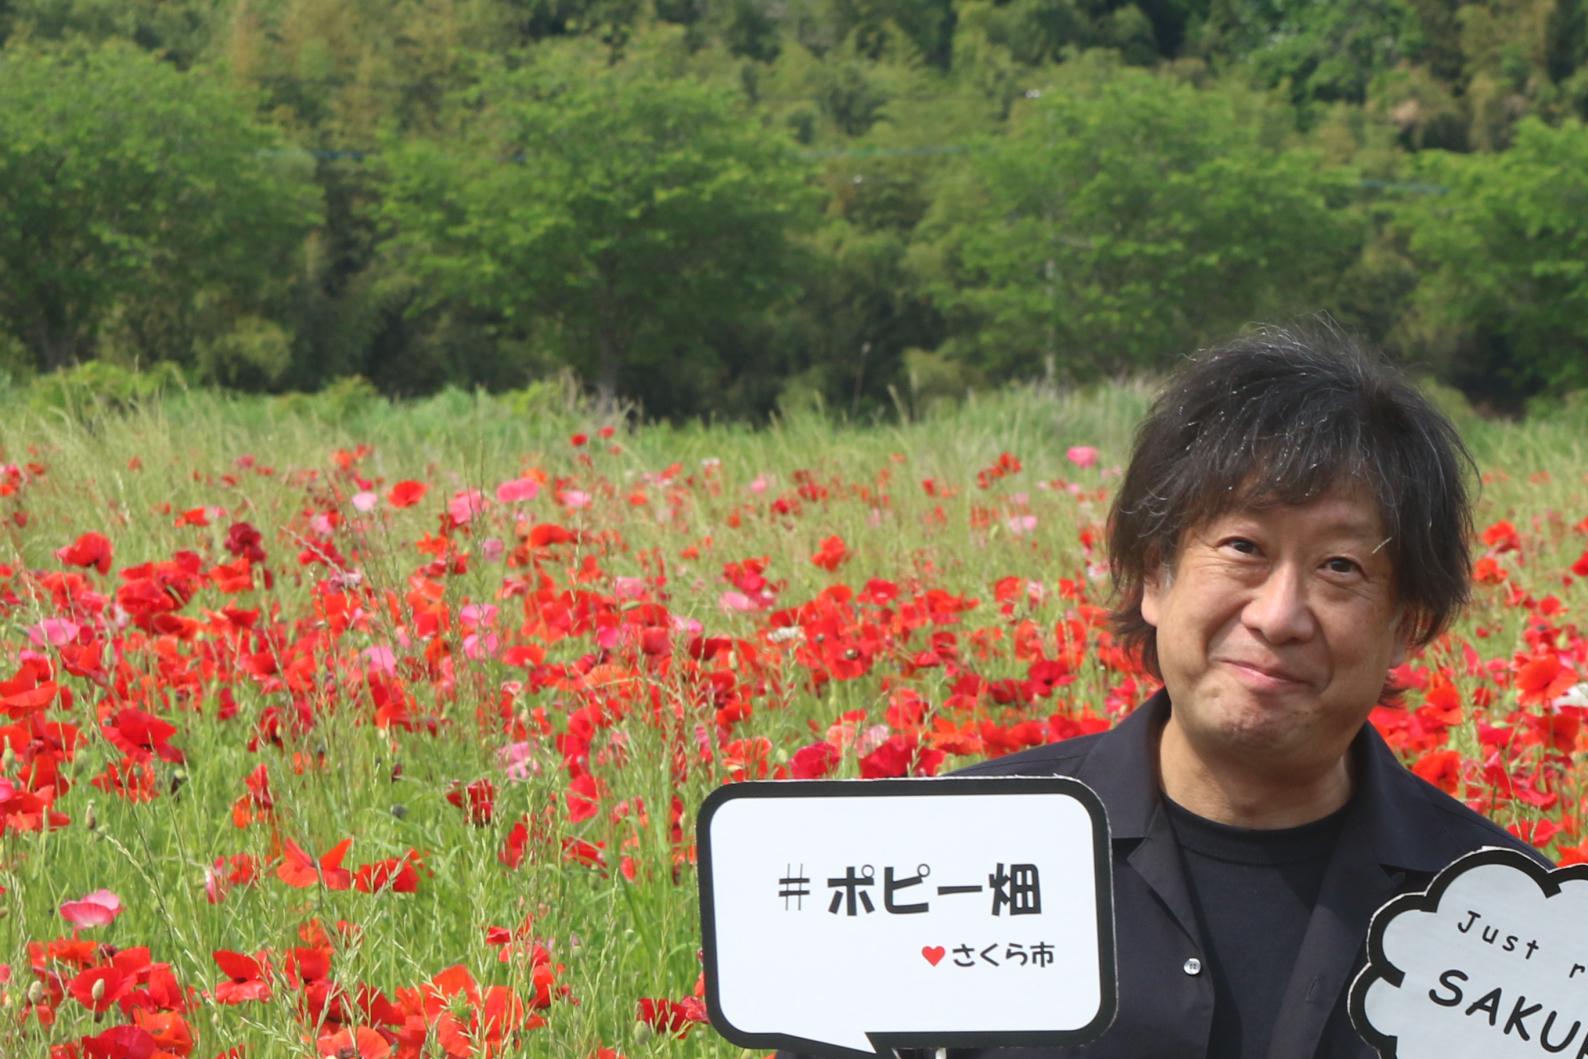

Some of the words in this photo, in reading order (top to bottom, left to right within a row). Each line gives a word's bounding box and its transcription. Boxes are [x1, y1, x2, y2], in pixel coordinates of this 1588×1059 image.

[1457, 910, 1540, 960] Just
[952, 941, 1056, 969] さくら市
